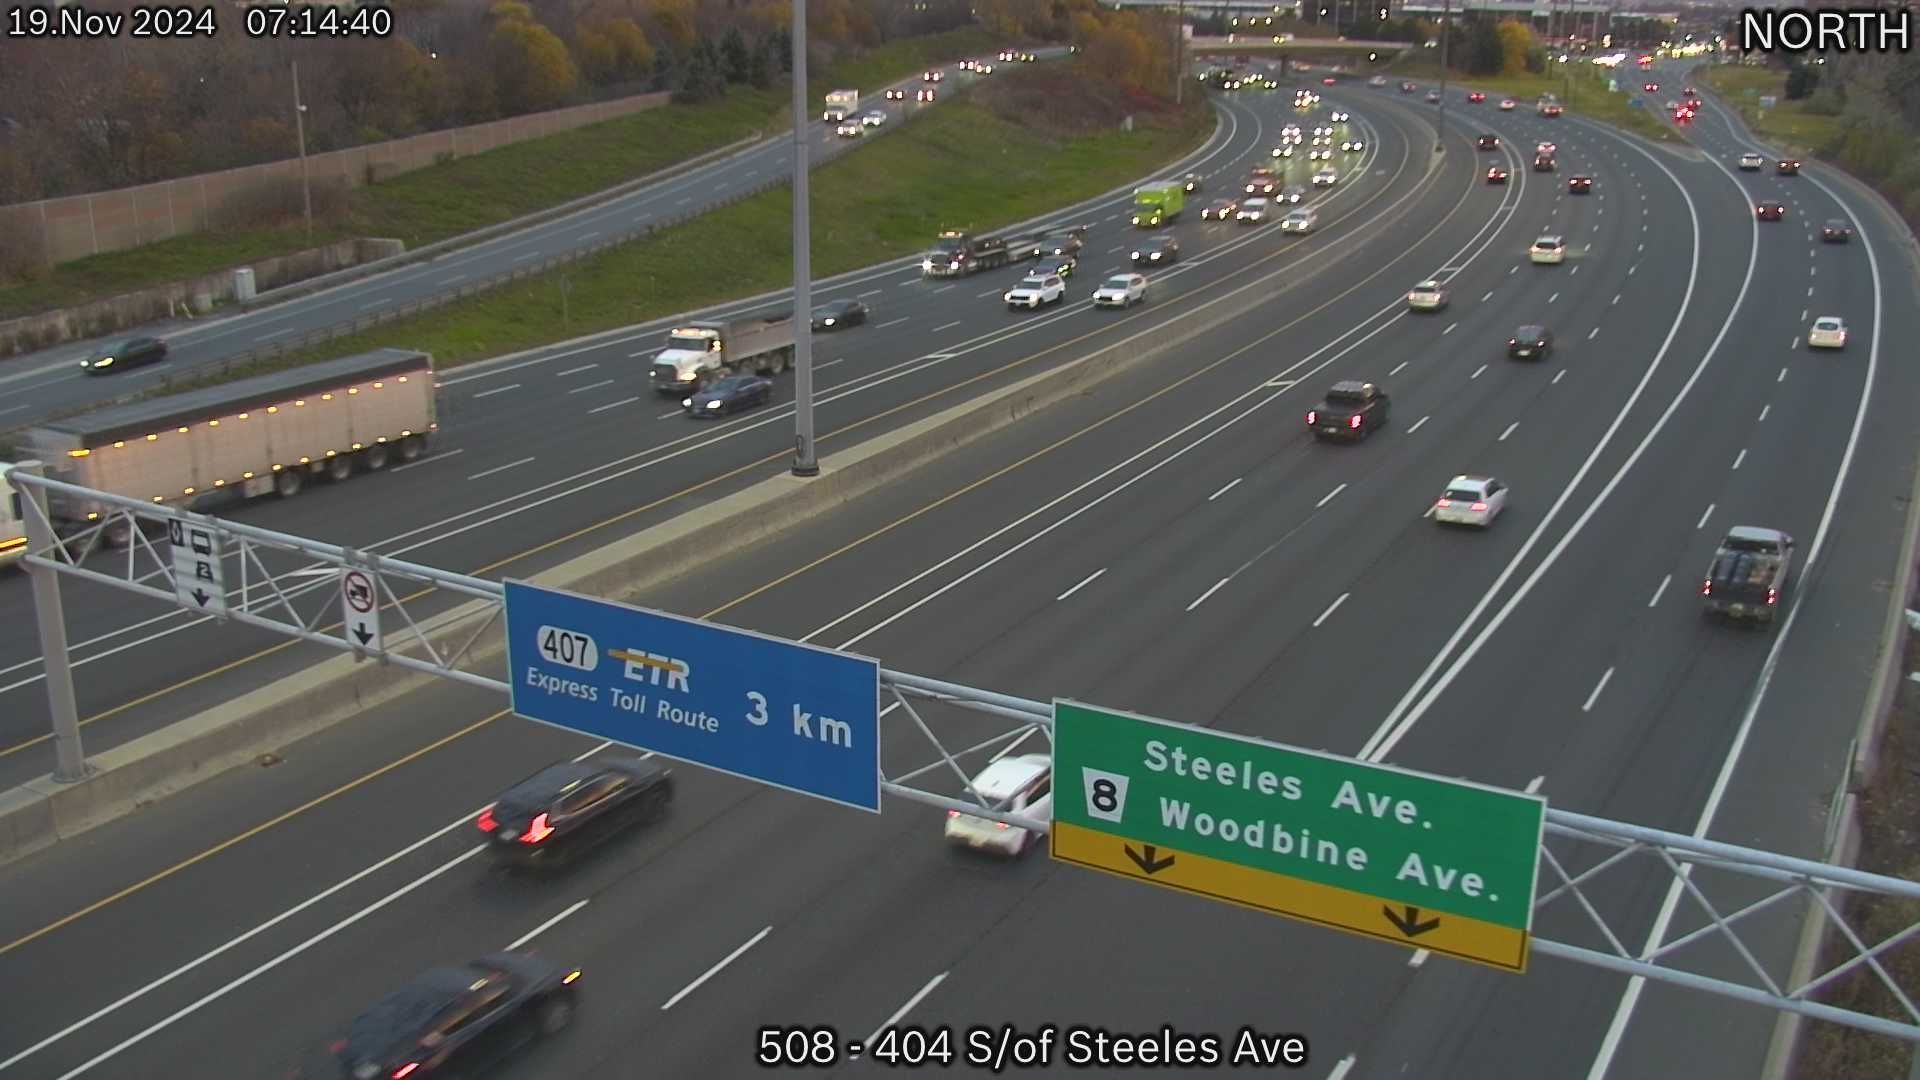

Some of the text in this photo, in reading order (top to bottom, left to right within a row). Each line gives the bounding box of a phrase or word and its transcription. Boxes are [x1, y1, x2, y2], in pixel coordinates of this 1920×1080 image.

[542, 629, 690, 693] 407 ETR
[527, 667, 719, 733] Express Toll Route
[745, 691, 852, 748] 3 km
[1091, 778, 1118, 812] 8
[1144, 740, 1432, 829] Steeles Ave.
[1160, 797, 1499, 902] Woodbine Ave.
